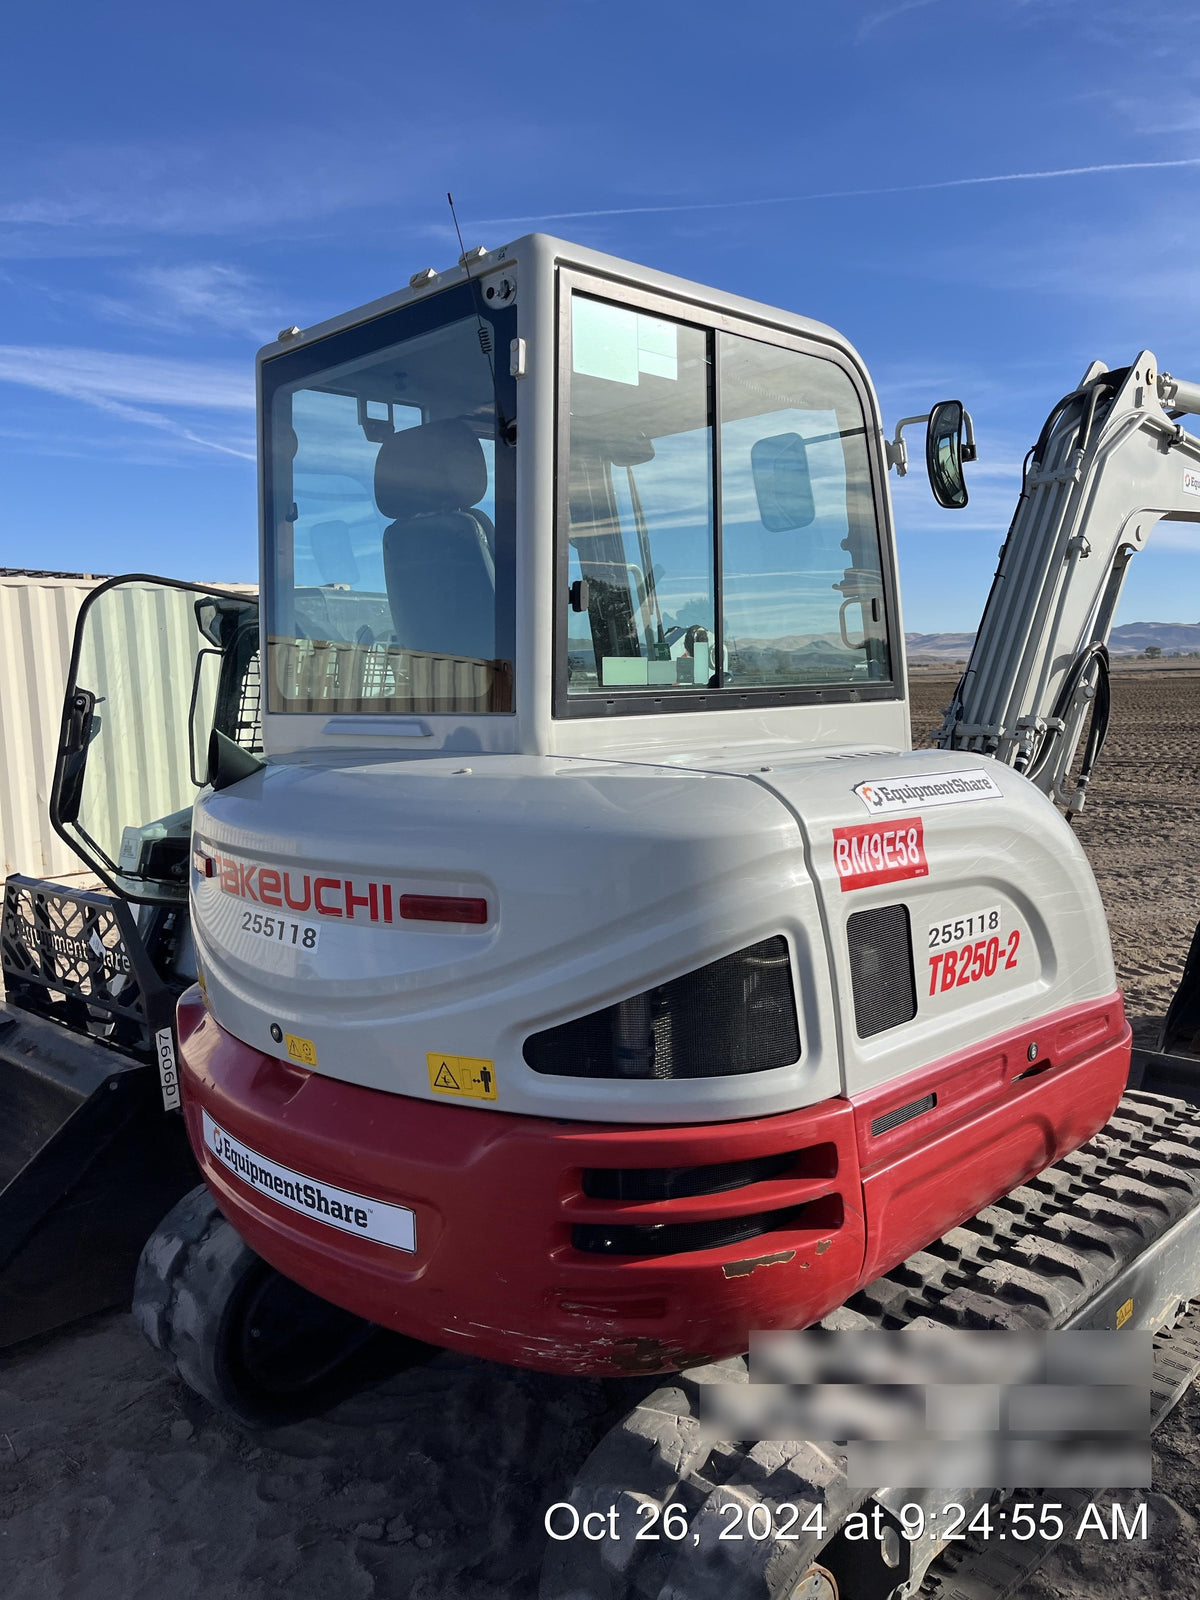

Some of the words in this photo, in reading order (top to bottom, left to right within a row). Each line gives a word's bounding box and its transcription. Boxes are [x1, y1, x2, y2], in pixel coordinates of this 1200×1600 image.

[879, 777, 992, 804] EquipmentShare
[836, 827, 920, 878] BM9E58
[241, 911, 317, 949] 255118
[928, 911, 999, 948] 255118
[928, 929, 1021, 997] TB250-2
